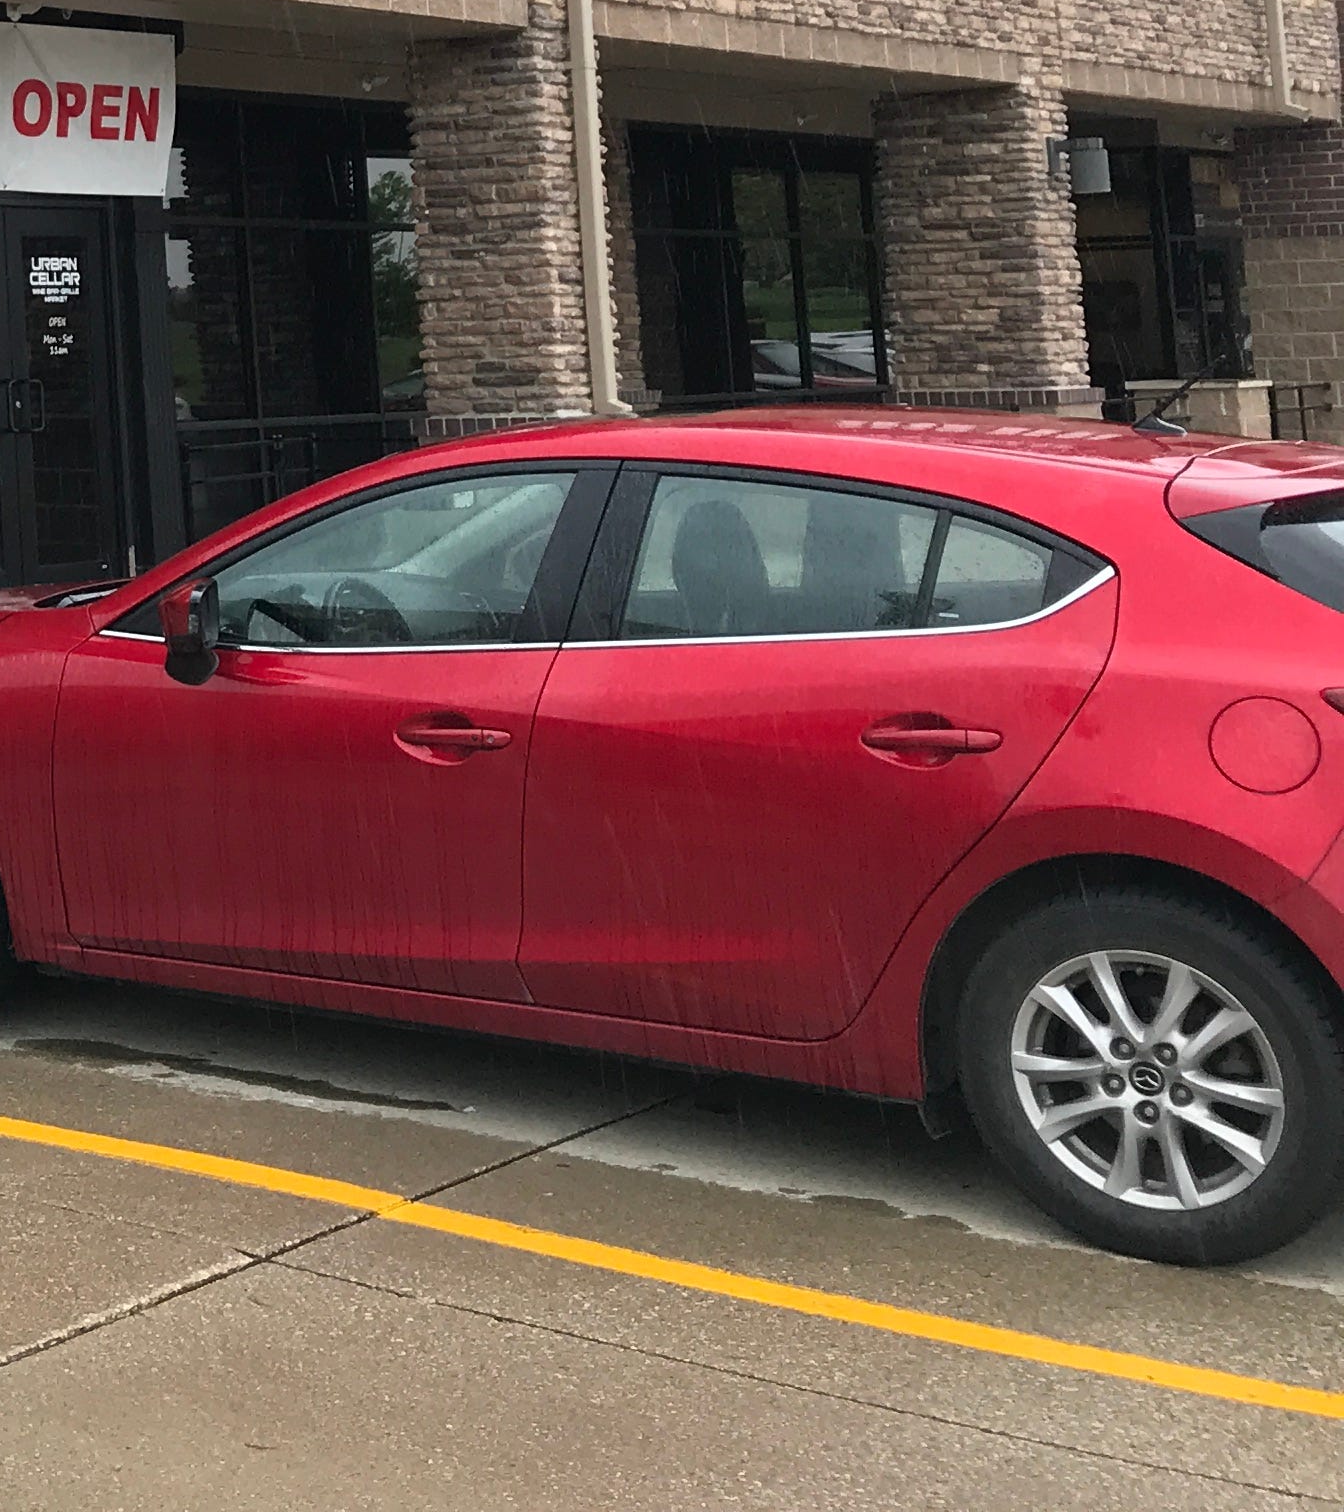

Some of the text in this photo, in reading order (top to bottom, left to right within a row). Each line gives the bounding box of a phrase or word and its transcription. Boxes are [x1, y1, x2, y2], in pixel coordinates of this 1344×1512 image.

[12, 79, 161, 143] OPEN
[30, 257, 78, 271] URBAN
[29, 272, 81, 286] CELLAR
[48, 316, 67, 328] OPEN
